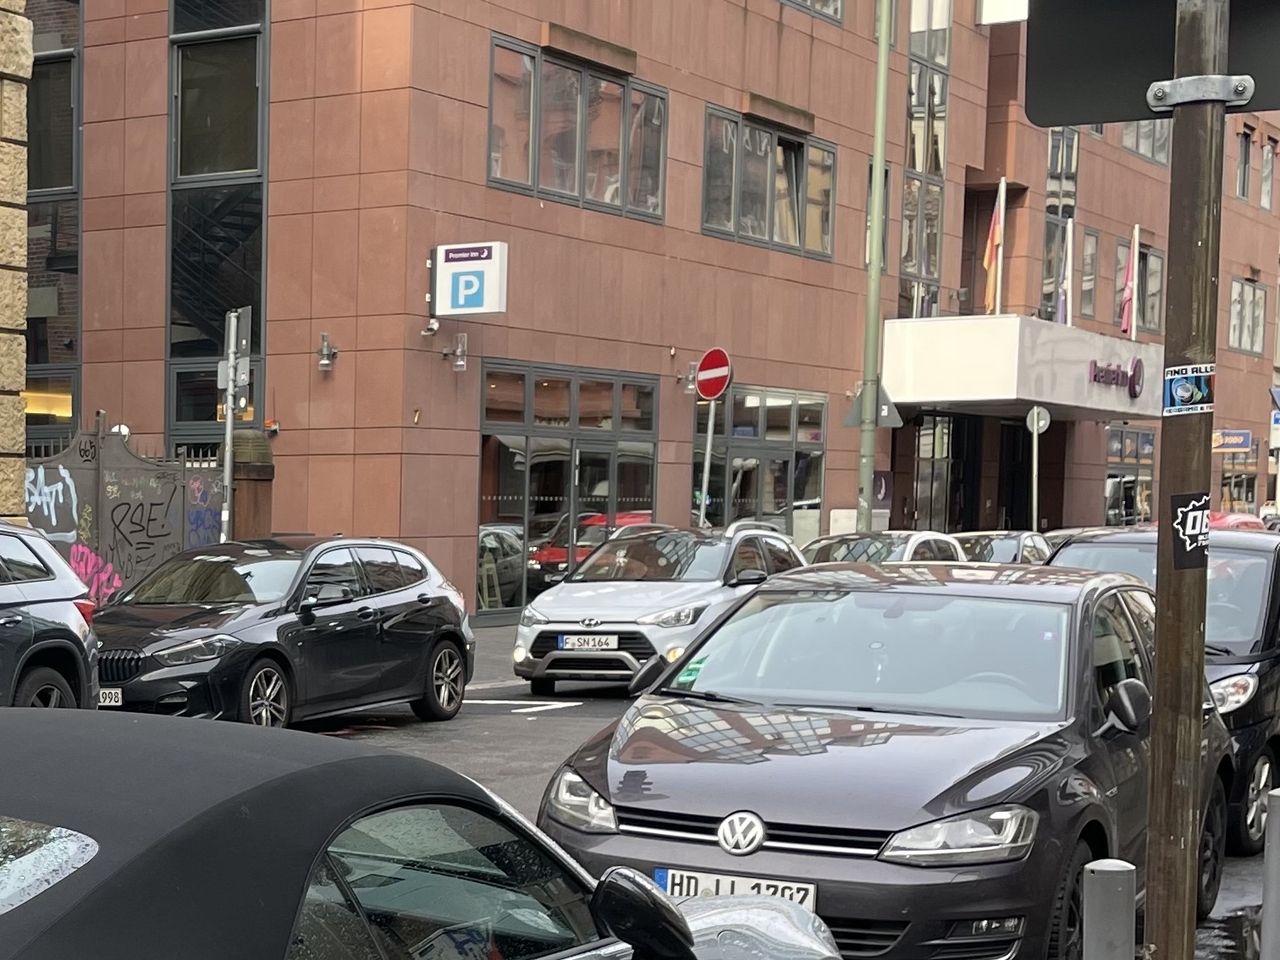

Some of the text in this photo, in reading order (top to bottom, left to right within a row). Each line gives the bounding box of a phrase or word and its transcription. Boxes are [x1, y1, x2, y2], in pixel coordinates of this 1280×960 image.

[458, 274, 480, 305] P
[591, 637, 610, 647] 164
[101, 691, 120, 703] 998
